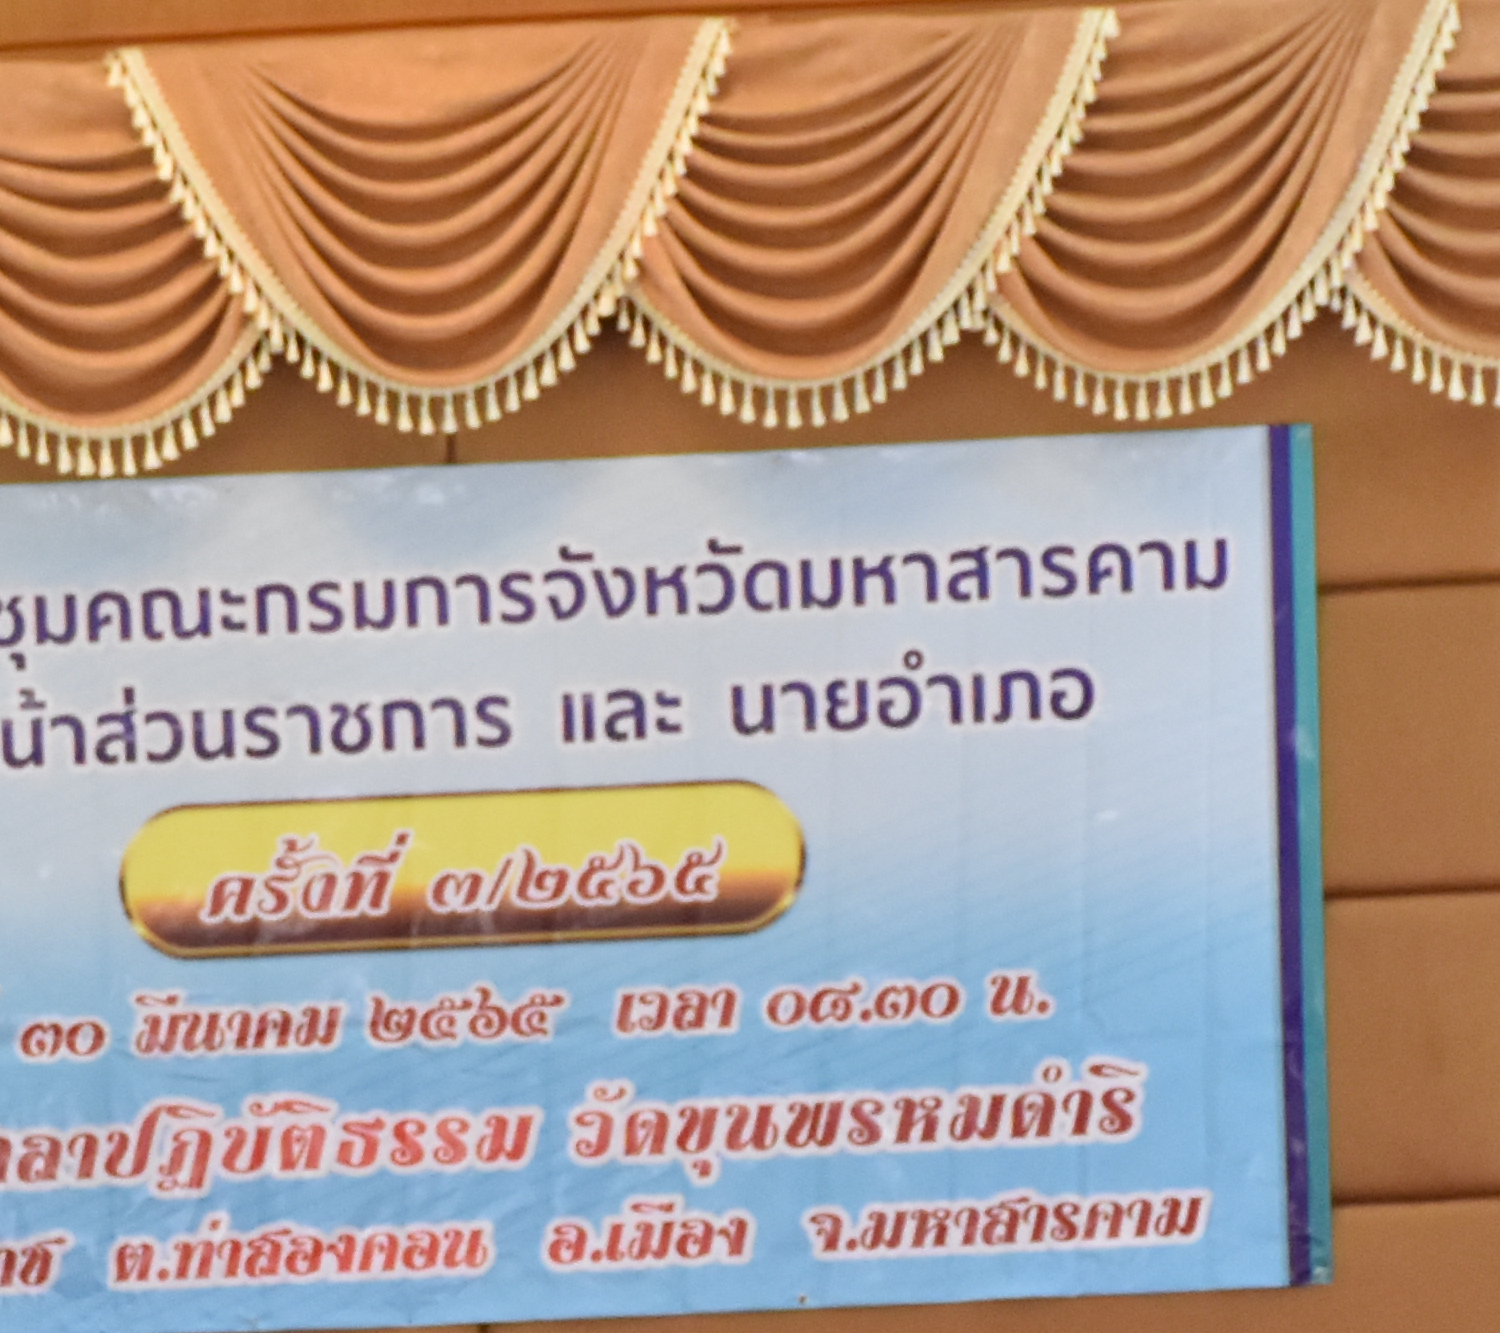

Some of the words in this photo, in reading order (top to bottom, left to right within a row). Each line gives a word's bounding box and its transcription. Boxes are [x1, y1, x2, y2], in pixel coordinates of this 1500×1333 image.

[561, 687, 682, 743] และ
[730, 649, 1096, 735] นายอำเภอ
[205, 831, 410, 918] ครั้งที่
[430, 839, 723, 911] ๓/๒๕๖๕
[20, 1019, 105, 1058] ๓๐
[134, 993, 342, 1055] มีนาคม
[368, 985, 564, 1045] ๒๕๖๕
[614, 986, 736, 1033] เวลา
[764, 980, 962, 1027] ๐๘.๓๐
[987, 975, 1052, 1017] น.
[571, 1061, 1143, 1179] วัดขุนพรหมดำริ
[112, 1215, 489, 1284] ต.ท่าสองคอน
[547, 1201, 750, 1265] อ.เมือง
[807, 1191, 1206, 1253] จ.มหาสารคาม
